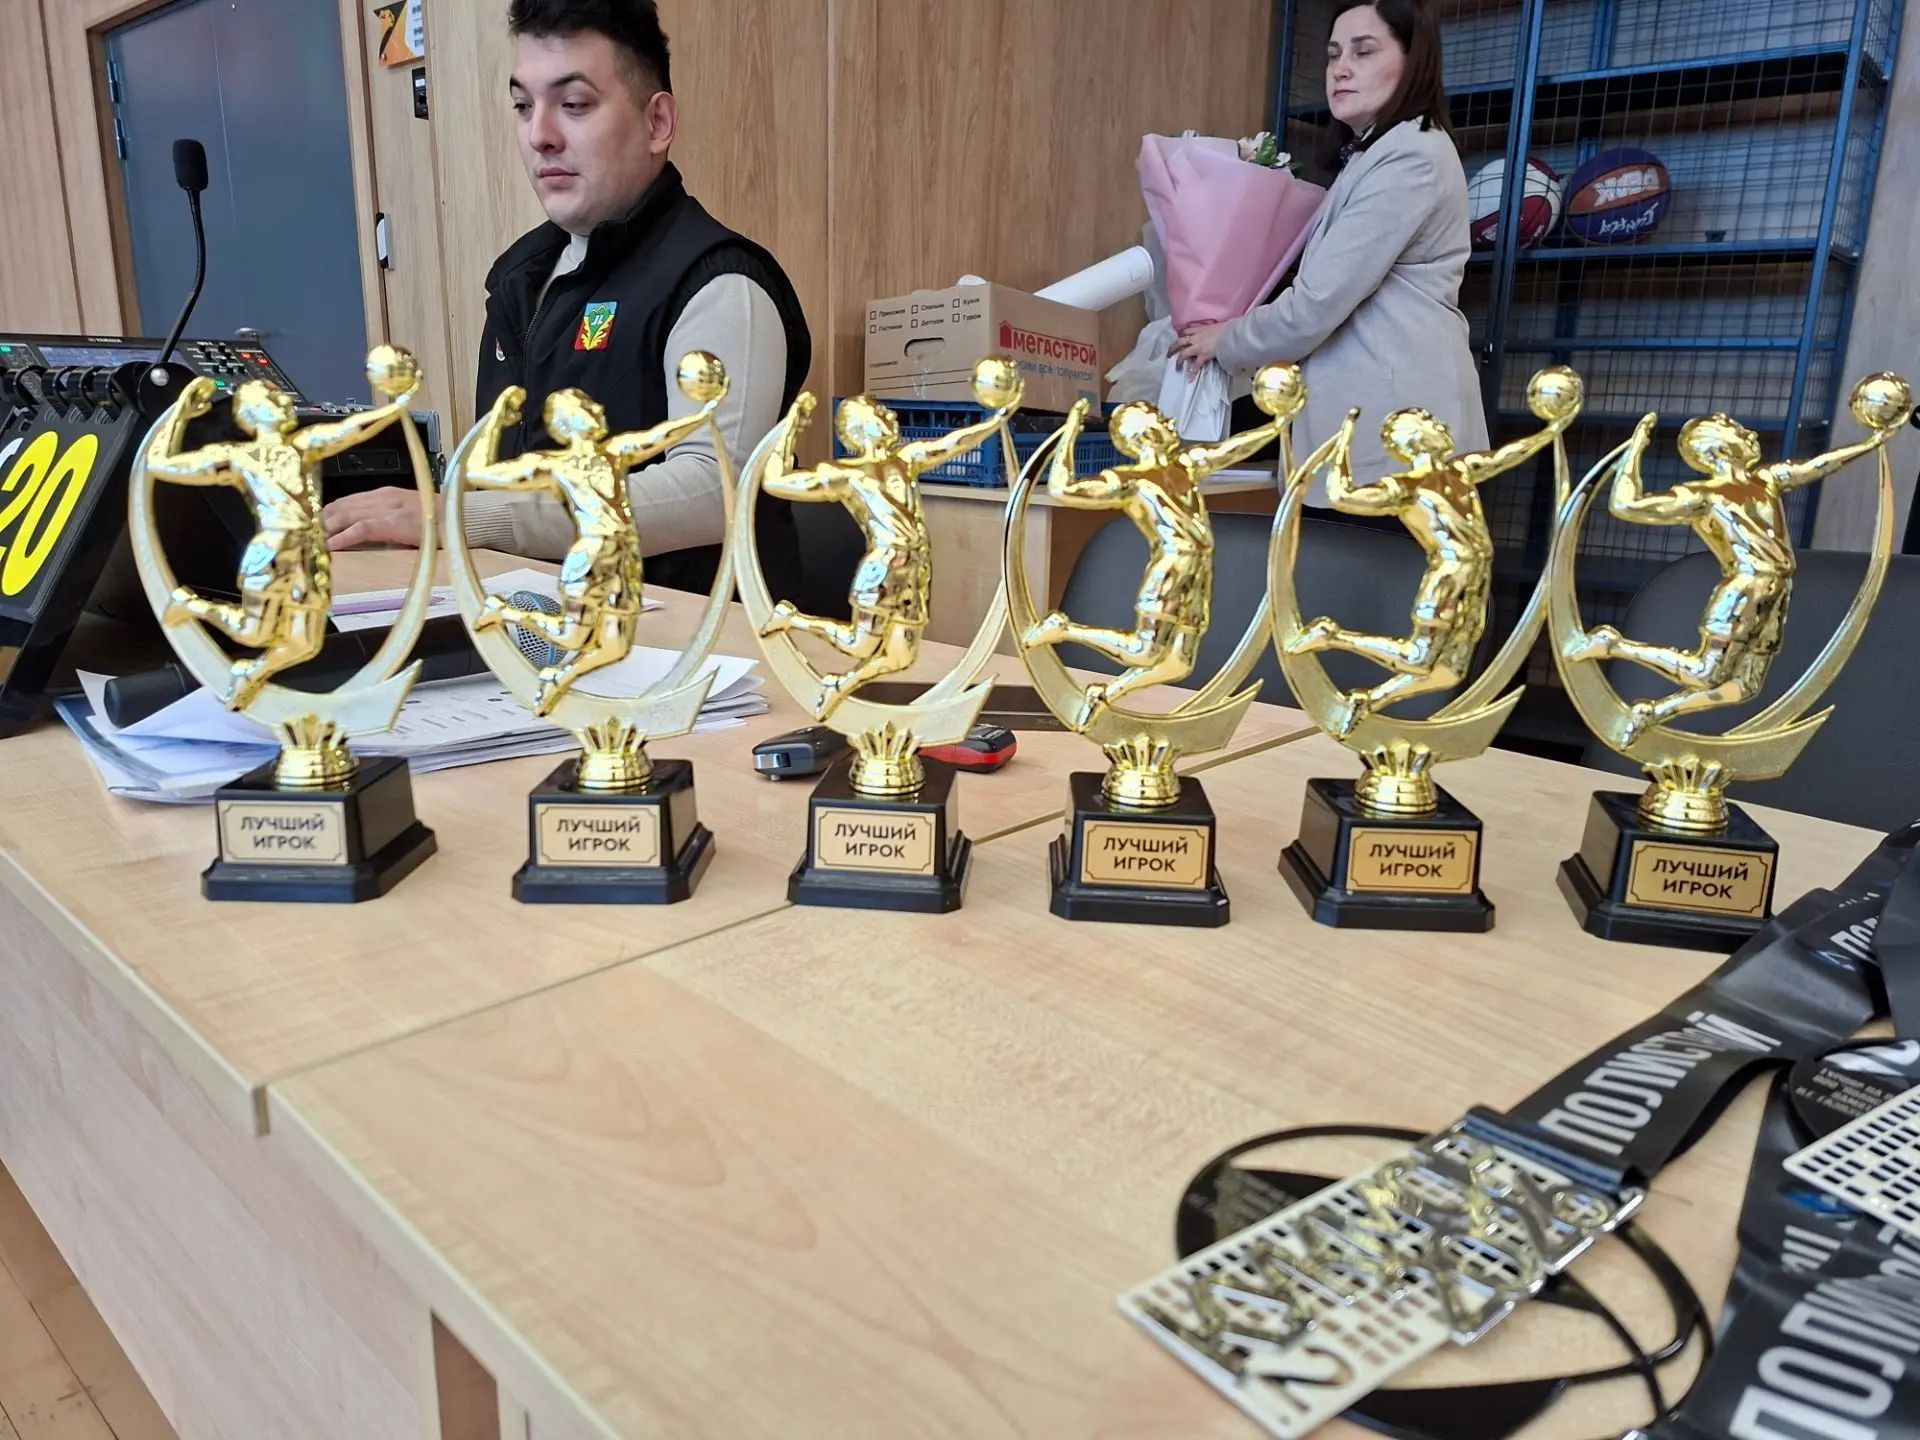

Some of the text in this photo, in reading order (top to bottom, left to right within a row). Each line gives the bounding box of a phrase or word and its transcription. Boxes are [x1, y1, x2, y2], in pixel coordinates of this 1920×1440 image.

[241, 813, 325, 831] ЛУЧШИЙ
[556, 816, 641, 833] ЛУЧШИЙ
[834, 822, 917, 841] ЛУЧШИЙ
[253, 835, 317, 849] ИГРОК
[568, 837, 632, 851] ИГРОК
[845, 842, 906, 858] ИГРОК
[1103, 836, 1188, 855] ЛУЧШИЙ
[1369, 841, 1456, 860] ЛУЧШИЙ
[1113, 856, 1176, 872] ИГРОК
[1379, 861, 1444, 878] ИГРОК
[1651, 858, 1749, 881] ЛУЧШИЙ
[1662, 878, 1734, 899] ИГРОК
